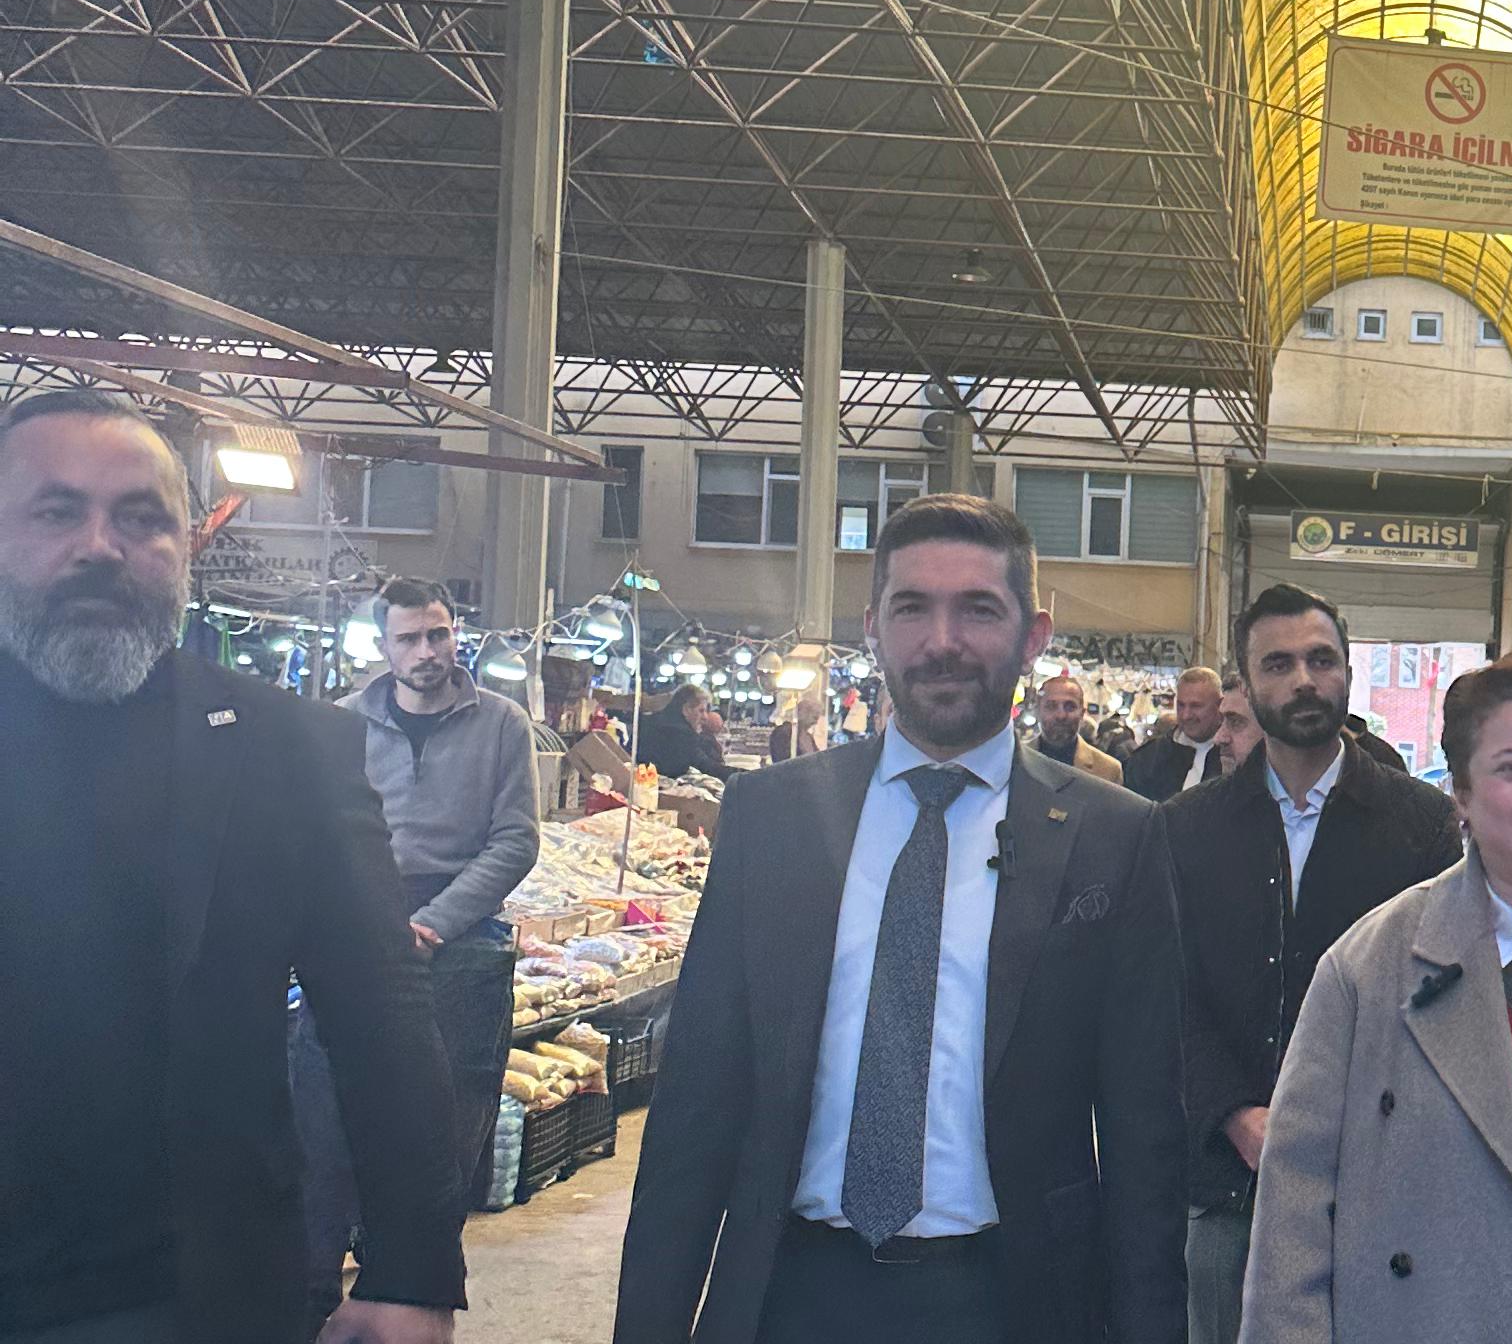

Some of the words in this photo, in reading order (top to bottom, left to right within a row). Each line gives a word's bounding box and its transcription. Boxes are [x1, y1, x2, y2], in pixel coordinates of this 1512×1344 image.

[1347, 123, 1445, 160] SİGARA
[1340, 521, 1356, 540] F
[1380, 519, 1468, 549] GİRİŞİ
